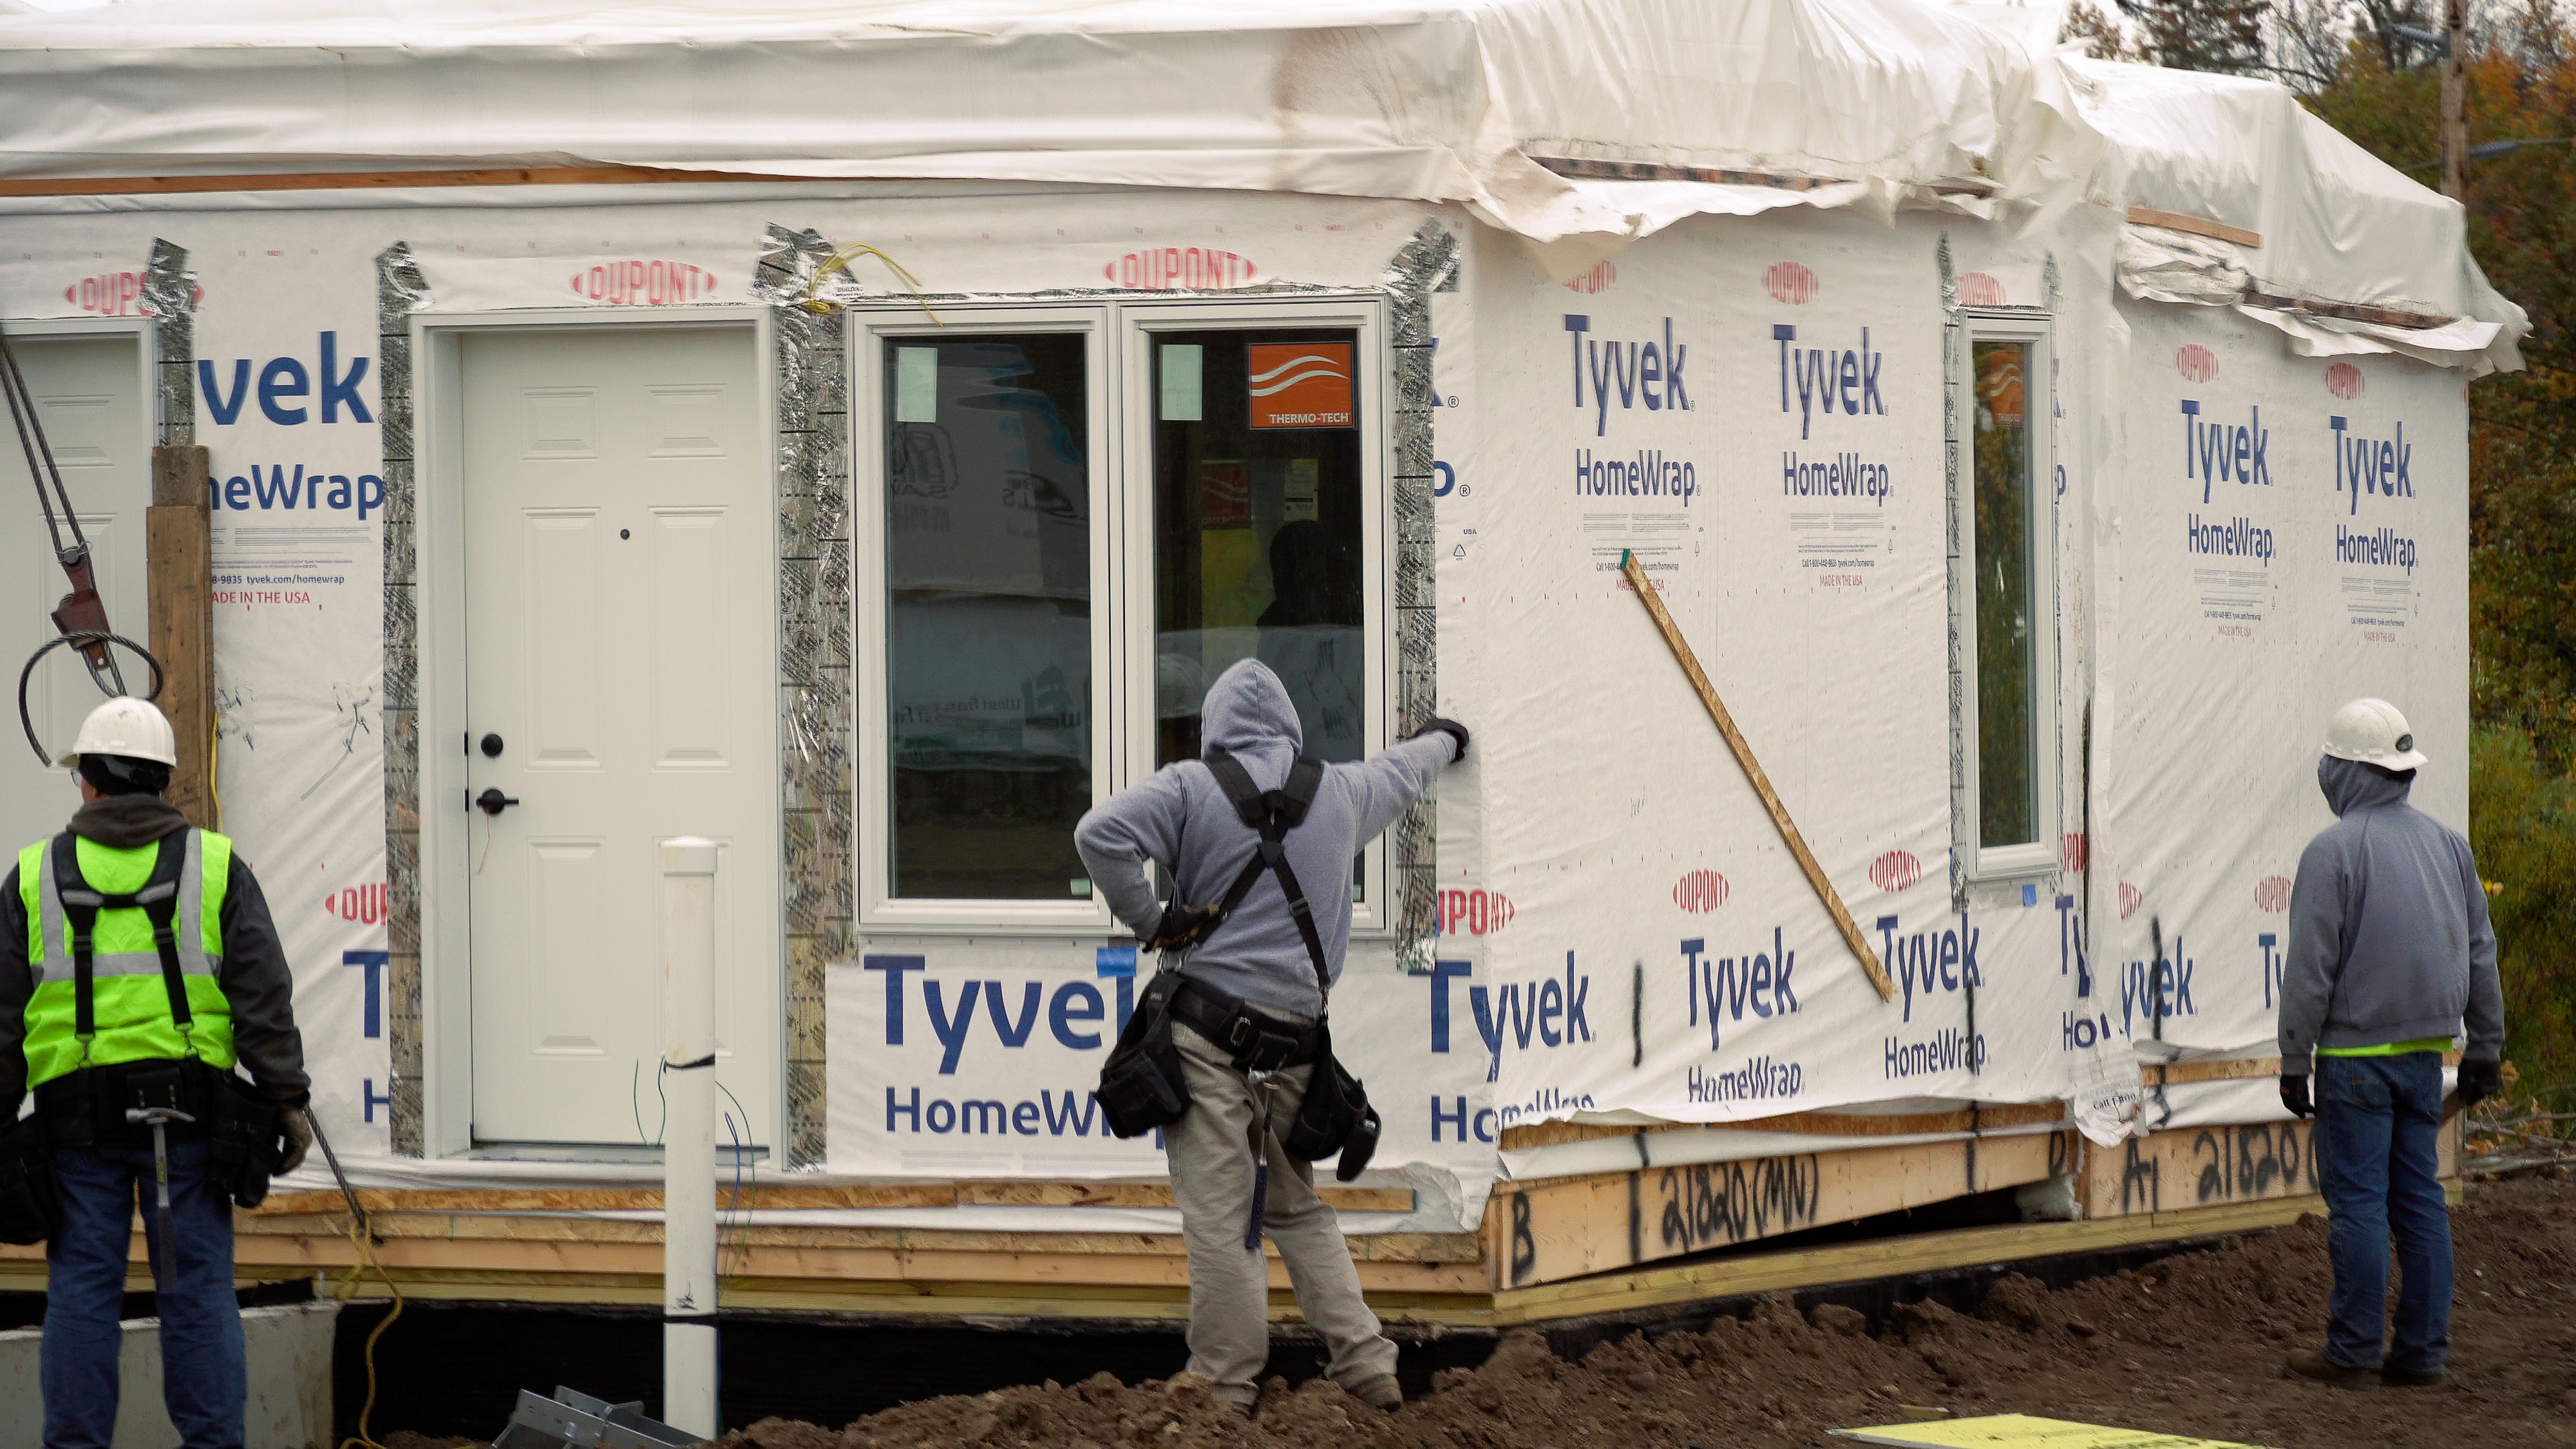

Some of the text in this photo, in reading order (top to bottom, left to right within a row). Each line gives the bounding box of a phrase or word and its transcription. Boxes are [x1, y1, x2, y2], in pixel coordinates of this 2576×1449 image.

[589, 260, 702, 305] DUPONT
[1123, 247, 1240, 290] DUPONT
[198, 330, 375, 426] vek
[2181, 344, 2214, 383] DUPONT
[2330, 363, 2362, 400] DUPONT
[1269, 412, 1349, 424] THERMO-TECH
[211, 592, 310, 604] ADE IN THE USA
[246, 574, 345, 586] tyvek.com/homewrap
[1653, 579, 1665, 591] USA
[1819, 574, 1863, 586] MADE IN THE USA
[1875, 849, 1916, 893] DUPONT
[1680, 869, 1723, 913] DUPONT
[1511, 1191, 1535, 1286] B
